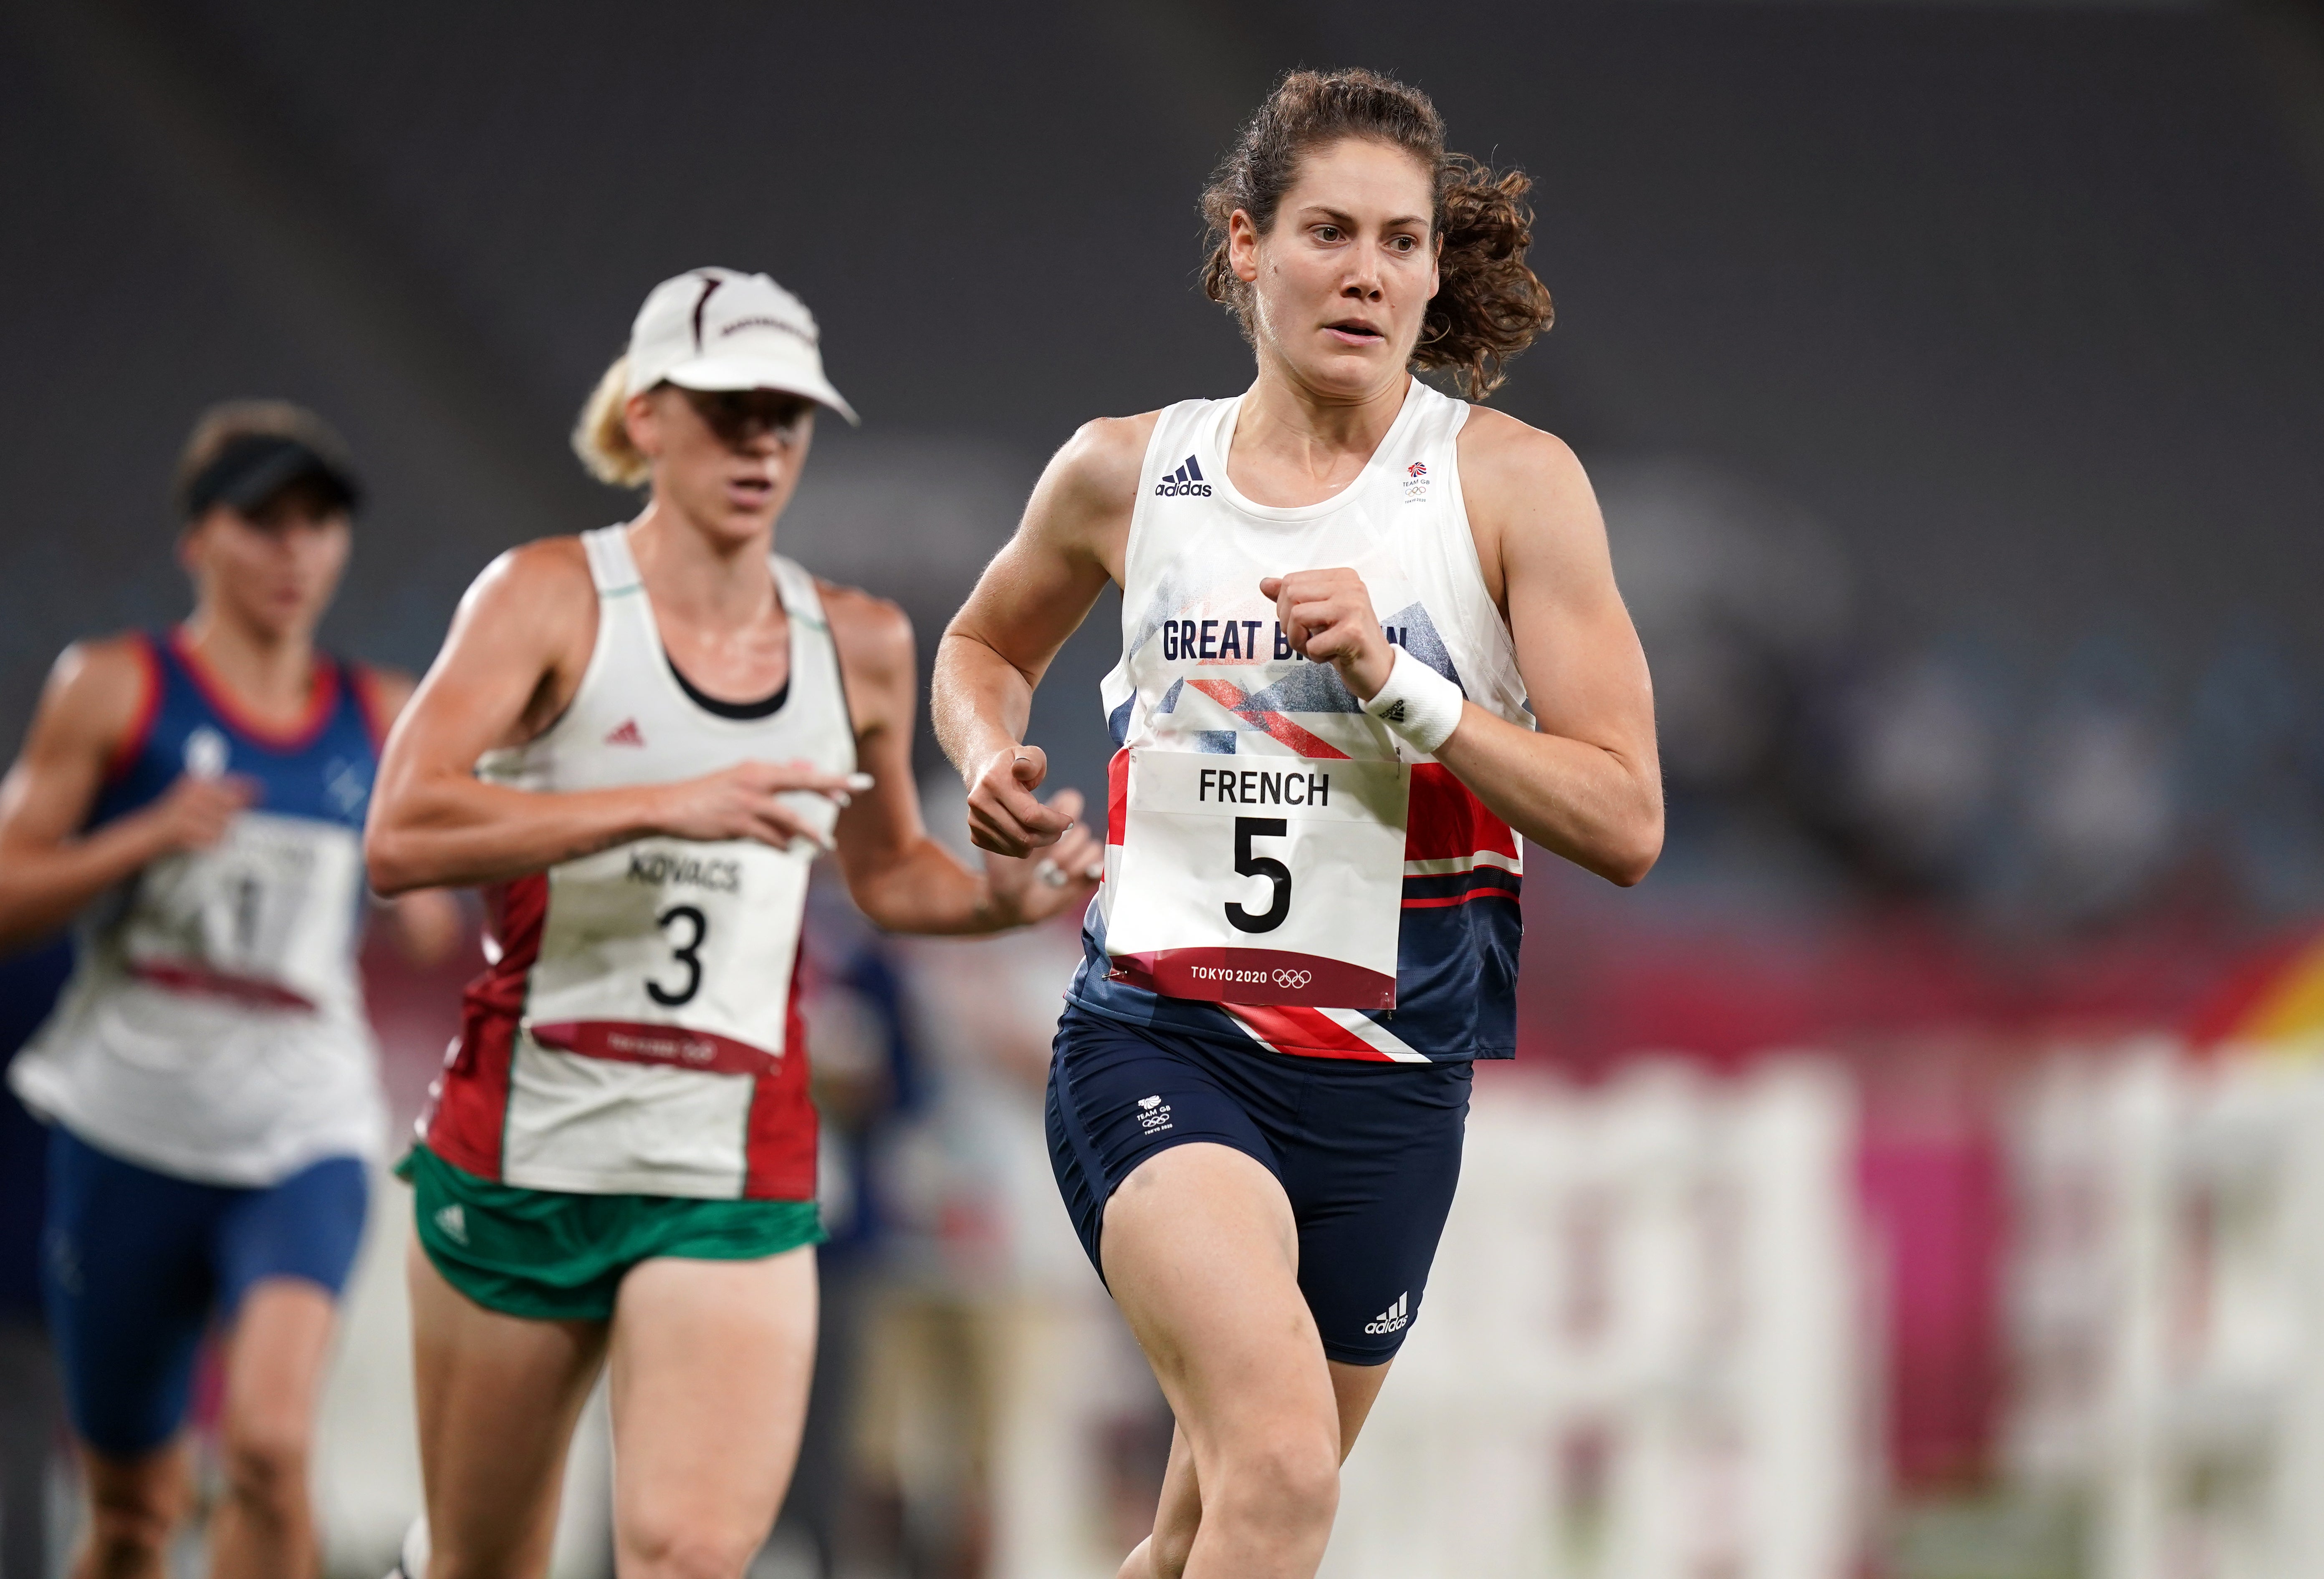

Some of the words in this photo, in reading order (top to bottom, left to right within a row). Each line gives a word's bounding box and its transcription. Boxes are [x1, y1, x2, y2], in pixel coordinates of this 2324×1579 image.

[1155, 481, 1212, 497] adidas
[1164, 620, 1262, 661] GREAT
[1200, 769, 1329, 806] FRENCH
[627, 853, 740, 892] KOVACS
[1225, 817, 1292, 933] 5
[646, 906, 707, 1007] 3
[1191, 966, 1233, 981] TOKYO
[1235, 970, 1267, 984] 2020
[1137, 1109, 1157, 1121] TEAM
[1144, 1127, 1160, 1135] TOKYO
[1364, 1315, 1408, 1334] adidas
